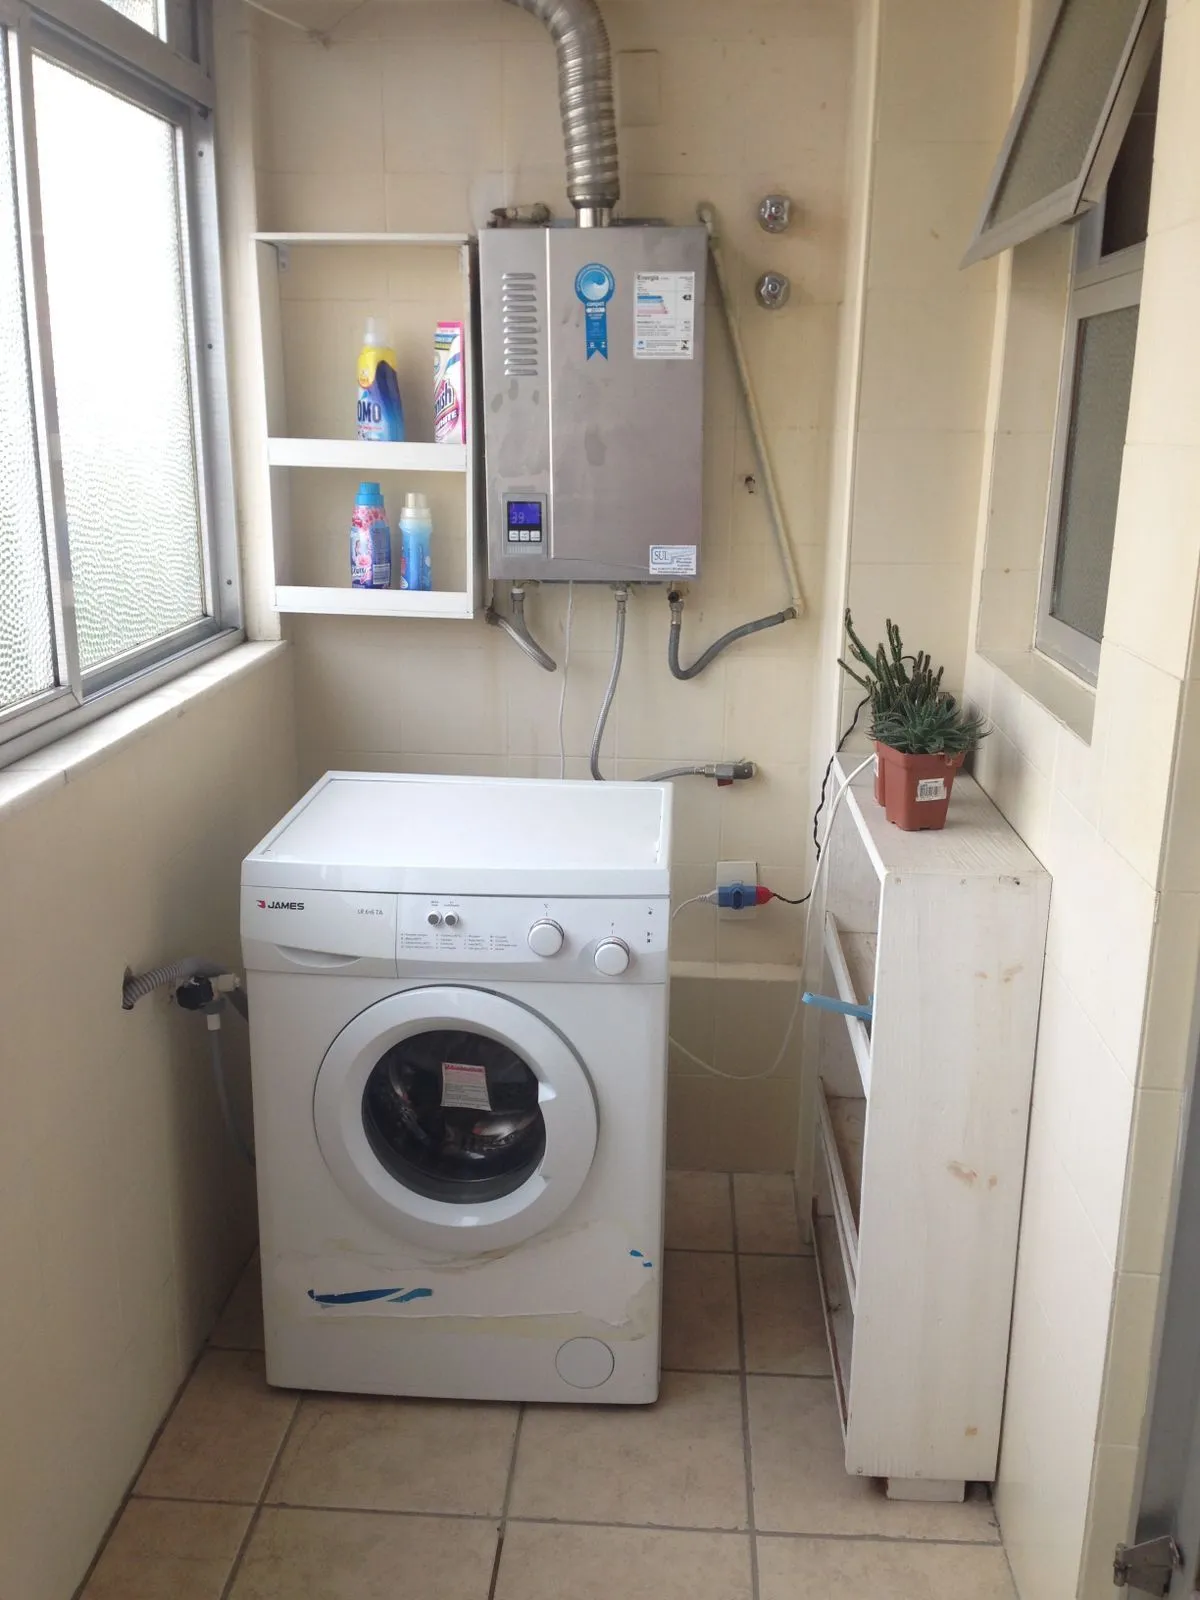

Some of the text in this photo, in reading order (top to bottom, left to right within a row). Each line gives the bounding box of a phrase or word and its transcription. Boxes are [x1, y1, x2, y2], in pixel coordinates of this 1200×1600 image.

[357, 399, 382, 423] OMO
[511, 511, 525, 524] 39
[654, 550, 670, 561] SUL
[267, 901, 305, 911] JAMES
